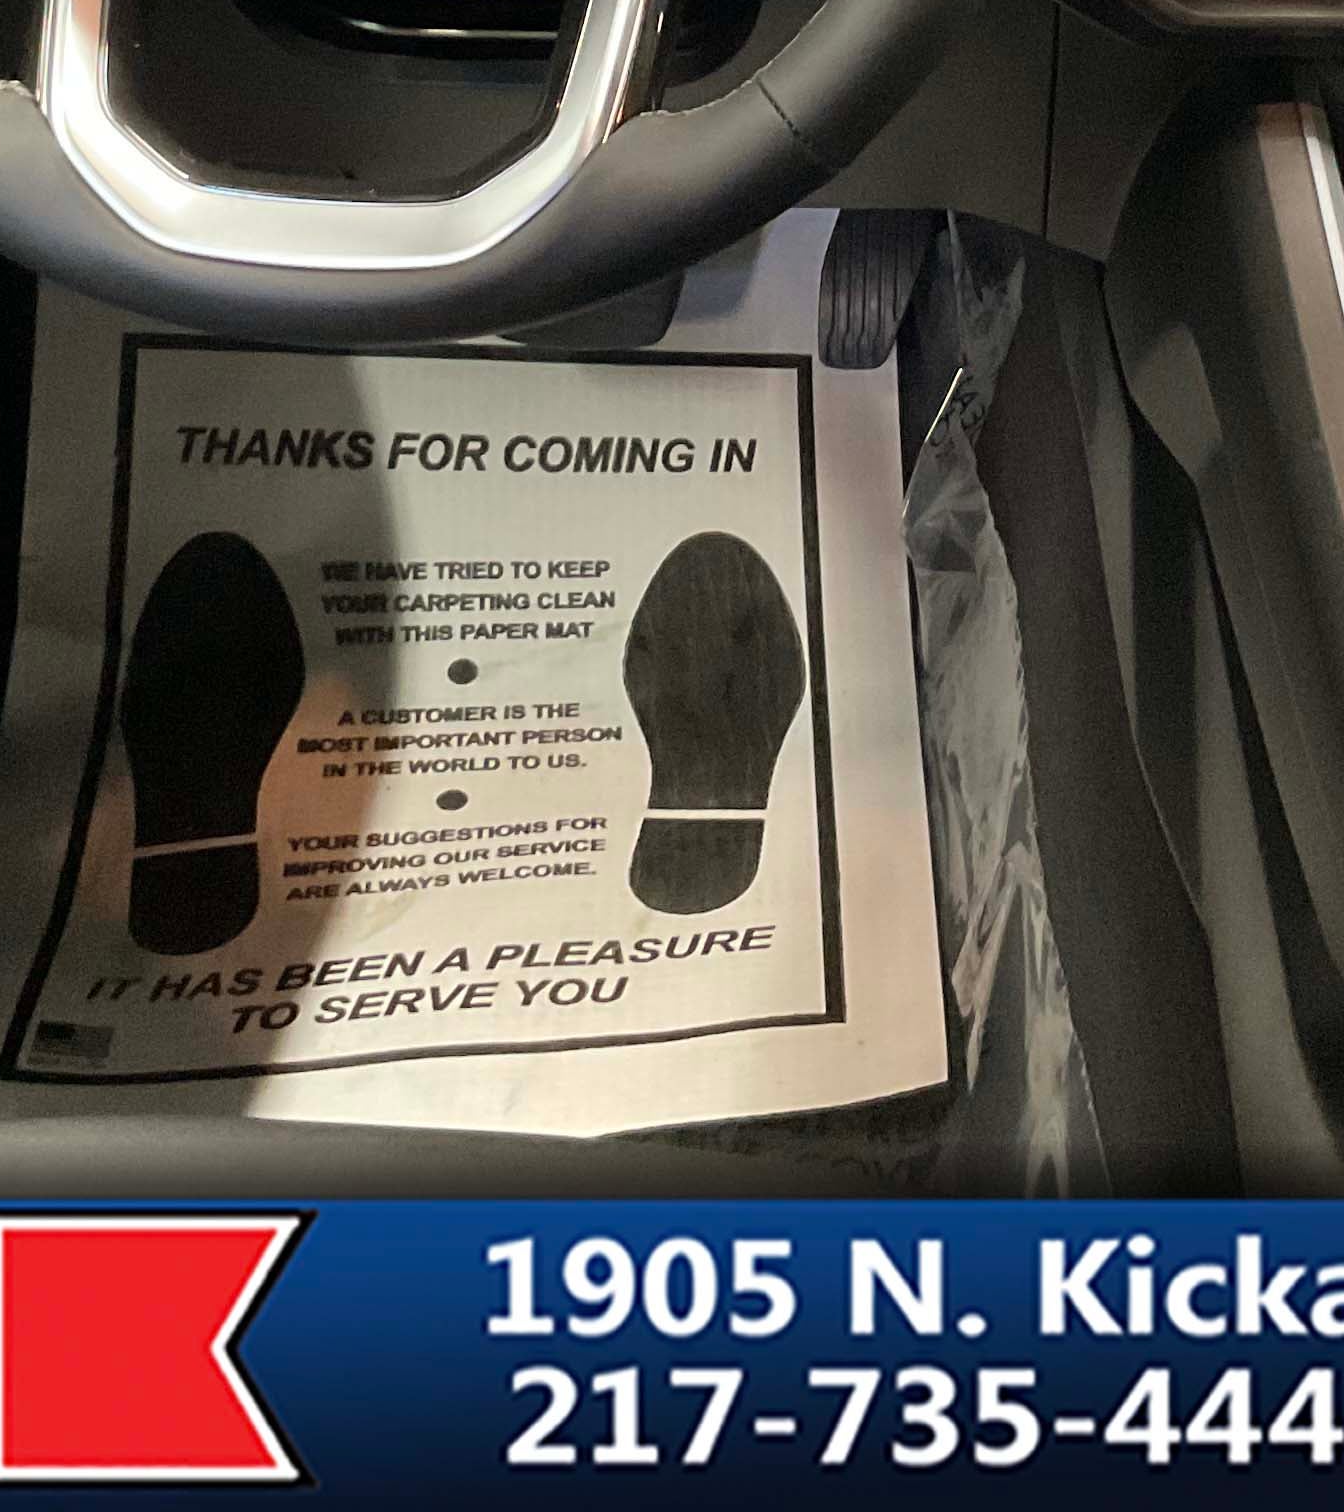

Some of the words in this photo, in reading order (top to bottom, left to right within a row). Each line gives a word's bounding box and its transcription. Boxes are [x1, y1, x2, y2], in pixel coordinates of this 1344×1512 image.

[176, 427, 375, 470] THANKS
[387, 432, 489, 472] FOR
[503, 434, 697, 474] COMING
[709, 437, 758, 474] IN
[321, 561, 362, 582] WE
[365, 561, 428, 581] HAVE
[434, 561, 504, 580] TRIED
[510, 561, 541, 579] TO
[548, 559, 611, 579] KEEP
[321, 593, 388, 614] YOUR
[394, 592, 531, 612] CARPETING
[537, 590, 616, 610] CLEAN
[335, 625, 394, 646] WITH
[401, 623, 454, 642] THIS
[460, 622, 540, 641] PAPER
[545, 621, 595, 639] MAT
[337, 709, 356, 726] A
[360, 705, 497, 726] CUSTOMER
[503, 704, 526, 720] IS
[532, 702, 581, 719] THE
[296, 736, 368, 754] MOST
[374, 730, 517, 753] IMPORTANT
[522, 726, 623, 745] PERSON
[322, 762, 348, 779] IN
[355, 759, 403, 778] THE
[408, 755, 502, 775] WORLD
[507, 755, 541, 772] TO
[547, 753, 589, 770] US.
[286, 833, 360, 853] YOUR
[365, 820, 549, 848] SUGGESTIONS
[555, 816, 608, 833] FOR
[282, 853, 427, 879] IMPROVING
[433, 846, 490, 866] OUR
[496, 838, 607, 860] SERVICE
[285, 884, 340, 903] ARE
[345, 874, 452, 898] ALWAYS
[457, 861, 598, 886] WELCOME.
[86, 976, 142, 1002] IT
[149, 967, 264, 1004] HAS
[274, 950, 426, 994] BEEN
[432, 947, 470, 975] A
[485, 924, 777, 971] PLEASURE
[230, 1001, 300, 1035] TO
[314, 981, 500, 1025] SERVE
[516, 975, 630, 1008] YOU
